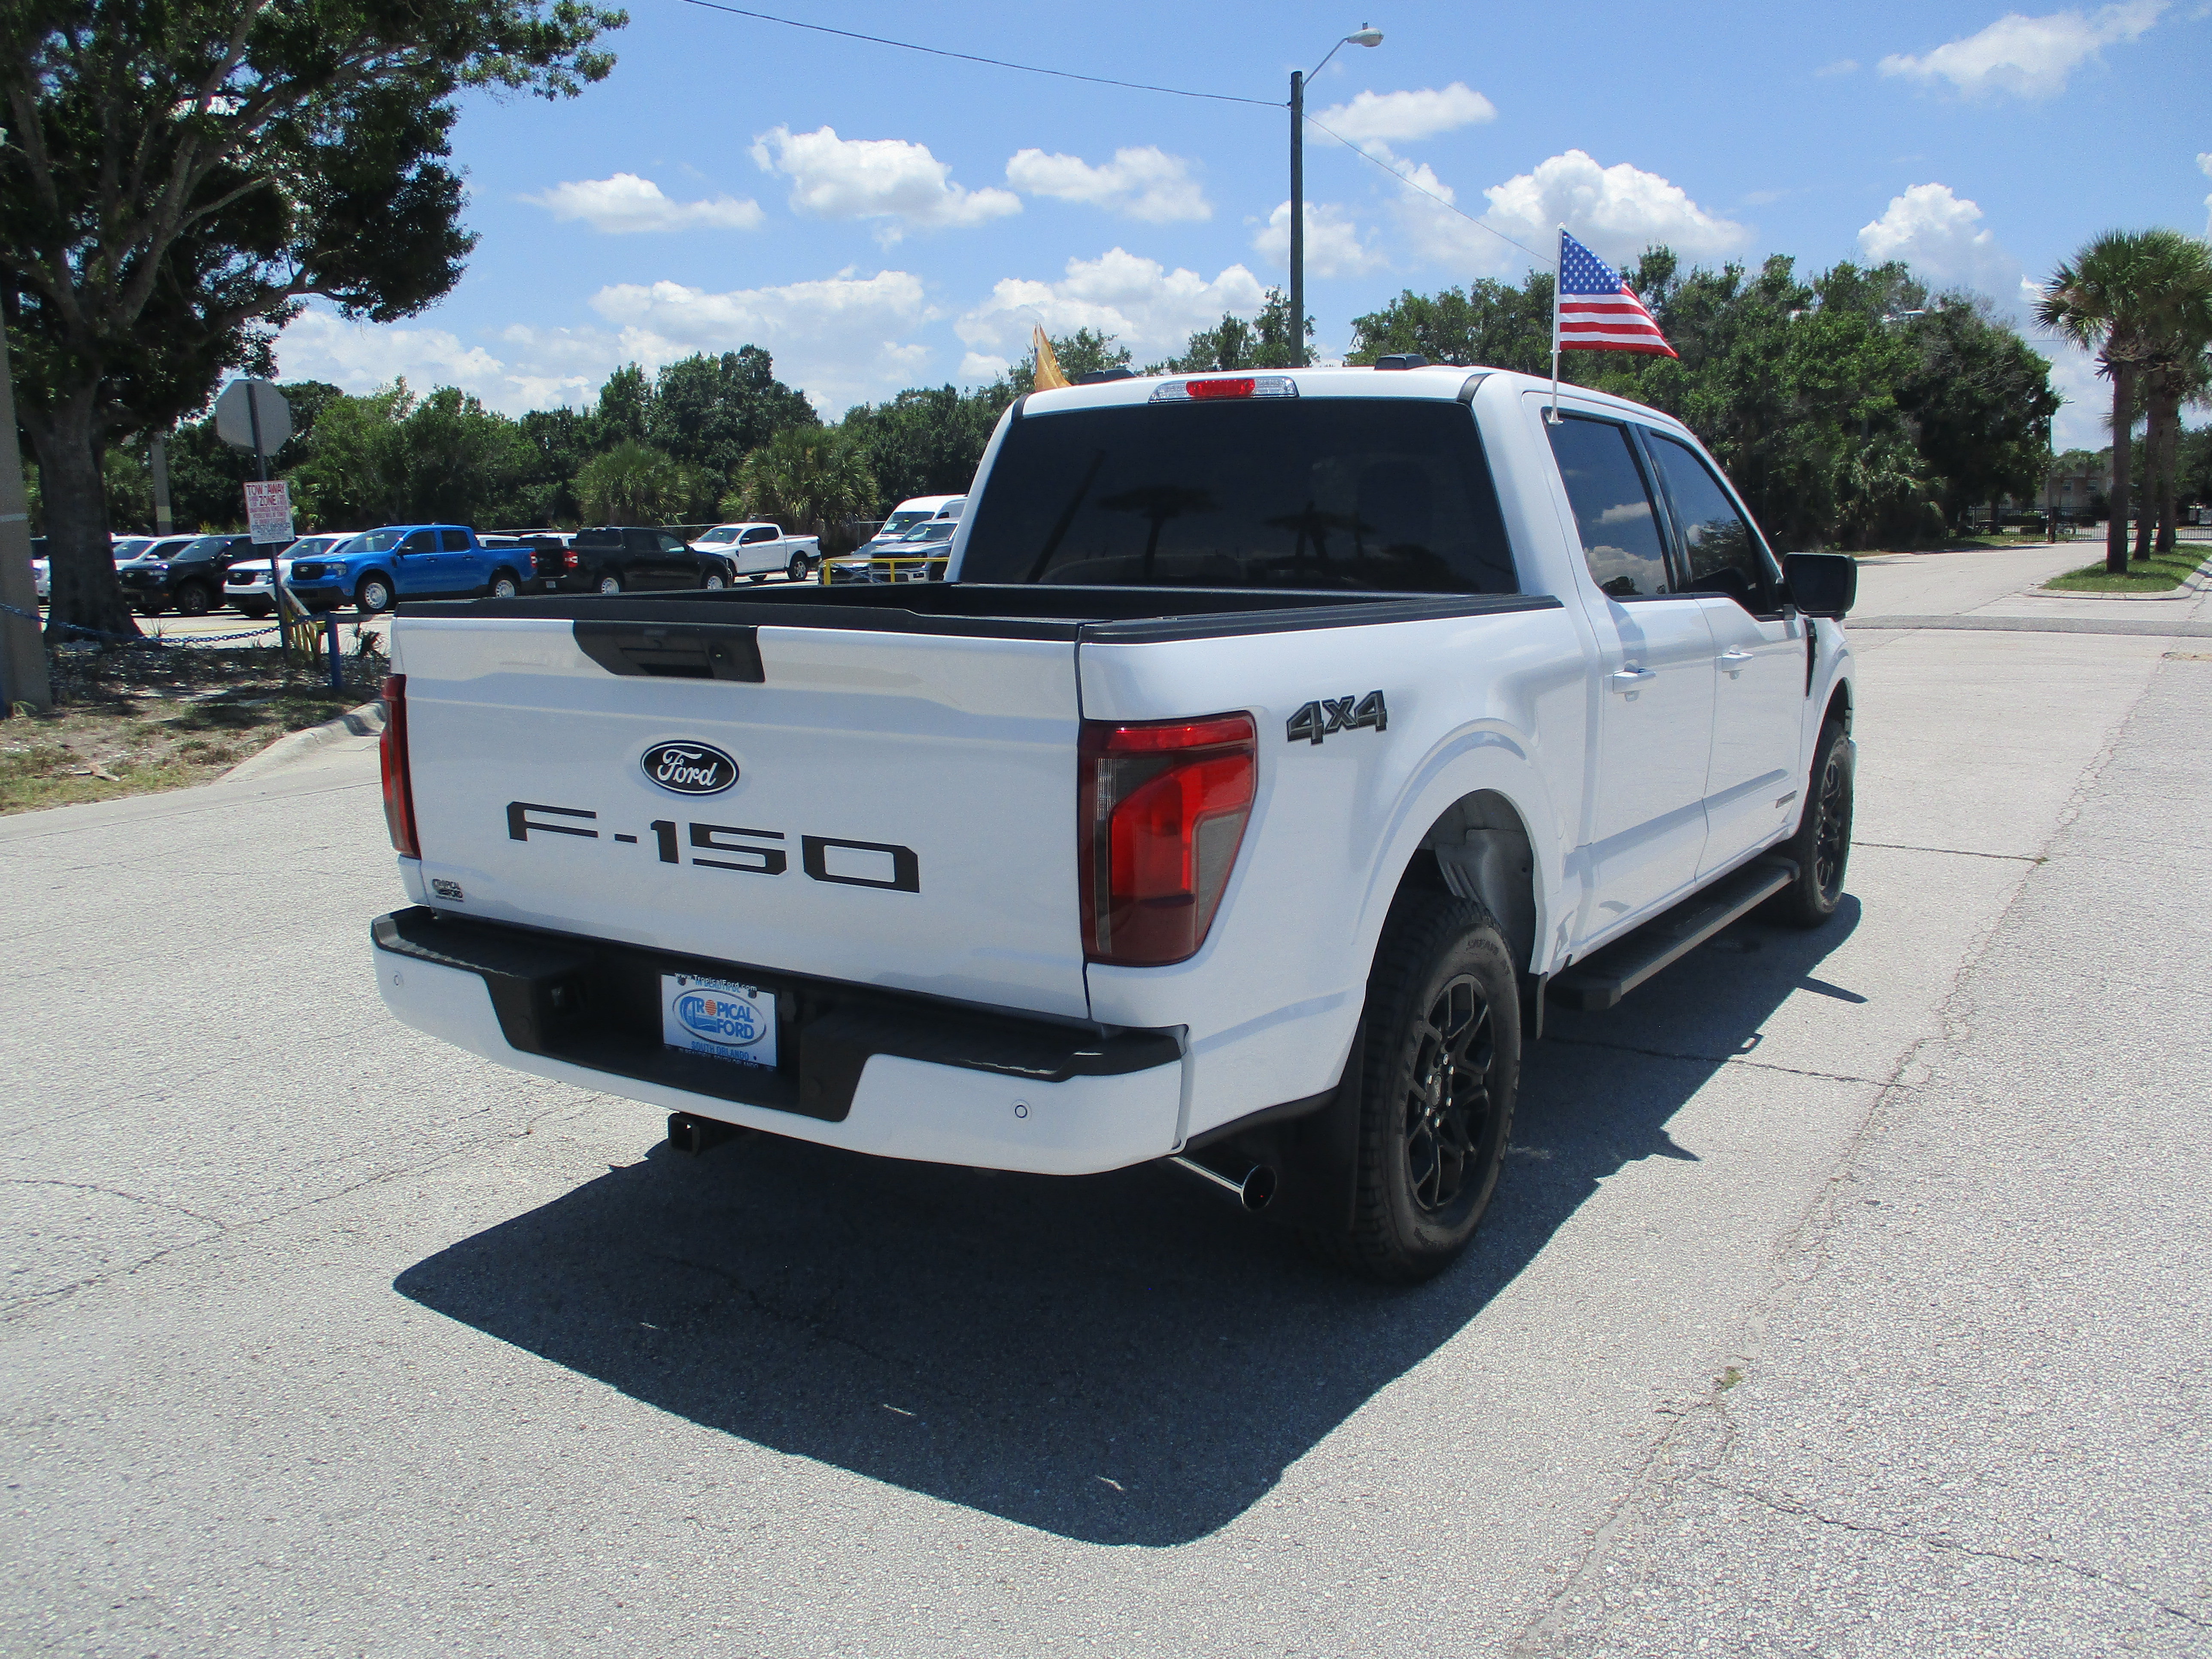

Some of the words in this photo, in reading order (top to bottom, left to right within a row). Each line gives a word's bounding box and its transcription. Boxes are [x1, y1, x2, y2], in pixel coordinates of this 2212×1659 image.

[258, 495, 276, 506] ZONE
[657, 748, 717, 787] Ford
[506, 801, 920, 893] F-150
[675, 972, 758, 991] www.TropicalFord.com
[680, 996, 754, 1024] TROPICAL
[716, 1018, 754, 1039] FORD
[691, 1041, 714, 1053] SOUTH
[716, 1046, 749, 1061] ORLANDO
